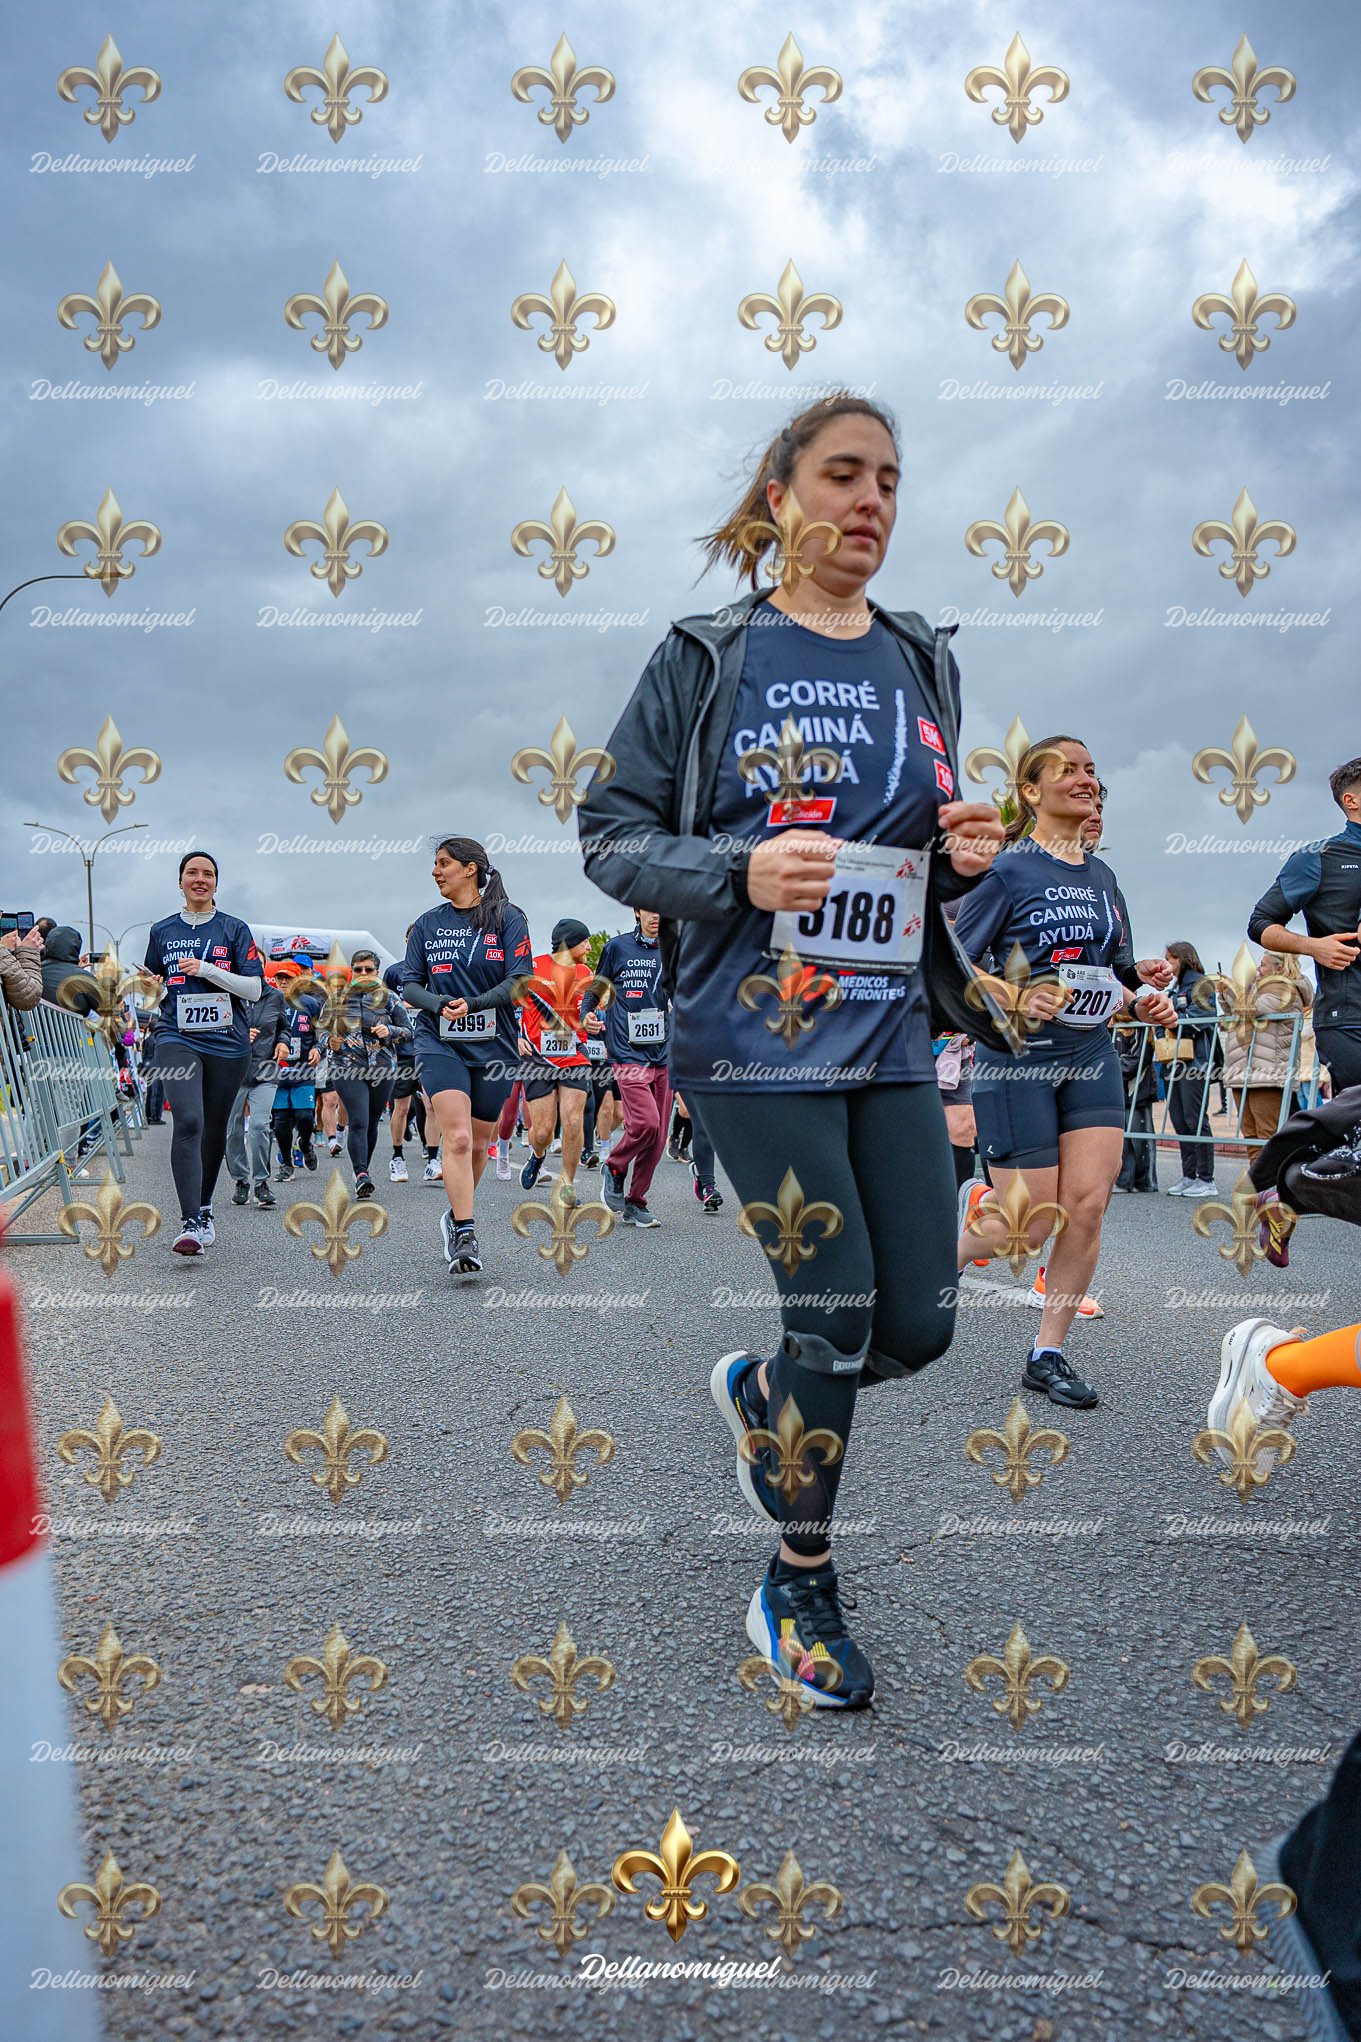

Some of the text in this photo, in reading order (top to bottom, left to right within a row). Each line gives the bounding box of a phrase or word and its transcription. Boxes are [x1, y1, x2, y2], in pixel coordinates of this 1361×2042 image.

[766, 680, 880, 710] CORRÉ
[734, 714, 874, 758] CAMINÁ
[922, 724, 942, 749] 5K
[1045, 886, 1098, 902] CORRÉ
[1029, 903, 1099, 926] CAMINÁ
[436, 926, 472, 937] CORRÉ
[1038, 922, 1094, 947] AYUDÁ
[167, 938, 201, 950] CORRÉ
[425, 938, 466, 950] CAMINÁ
[427, 949, 459, 962] AYUDÁ
[627, 959, 657, 968] CORRÉ
[620, 968, 652, 979] CAMINÁ
[623, 979, 648, 988] AYUDÁ
[1064, 989, 1112, 1016] 2207
[185, 1006, 219, 1024] 2725
[448, 1014, 486, 1032] 2999
[635, 1023, 660, 1037] 2631
